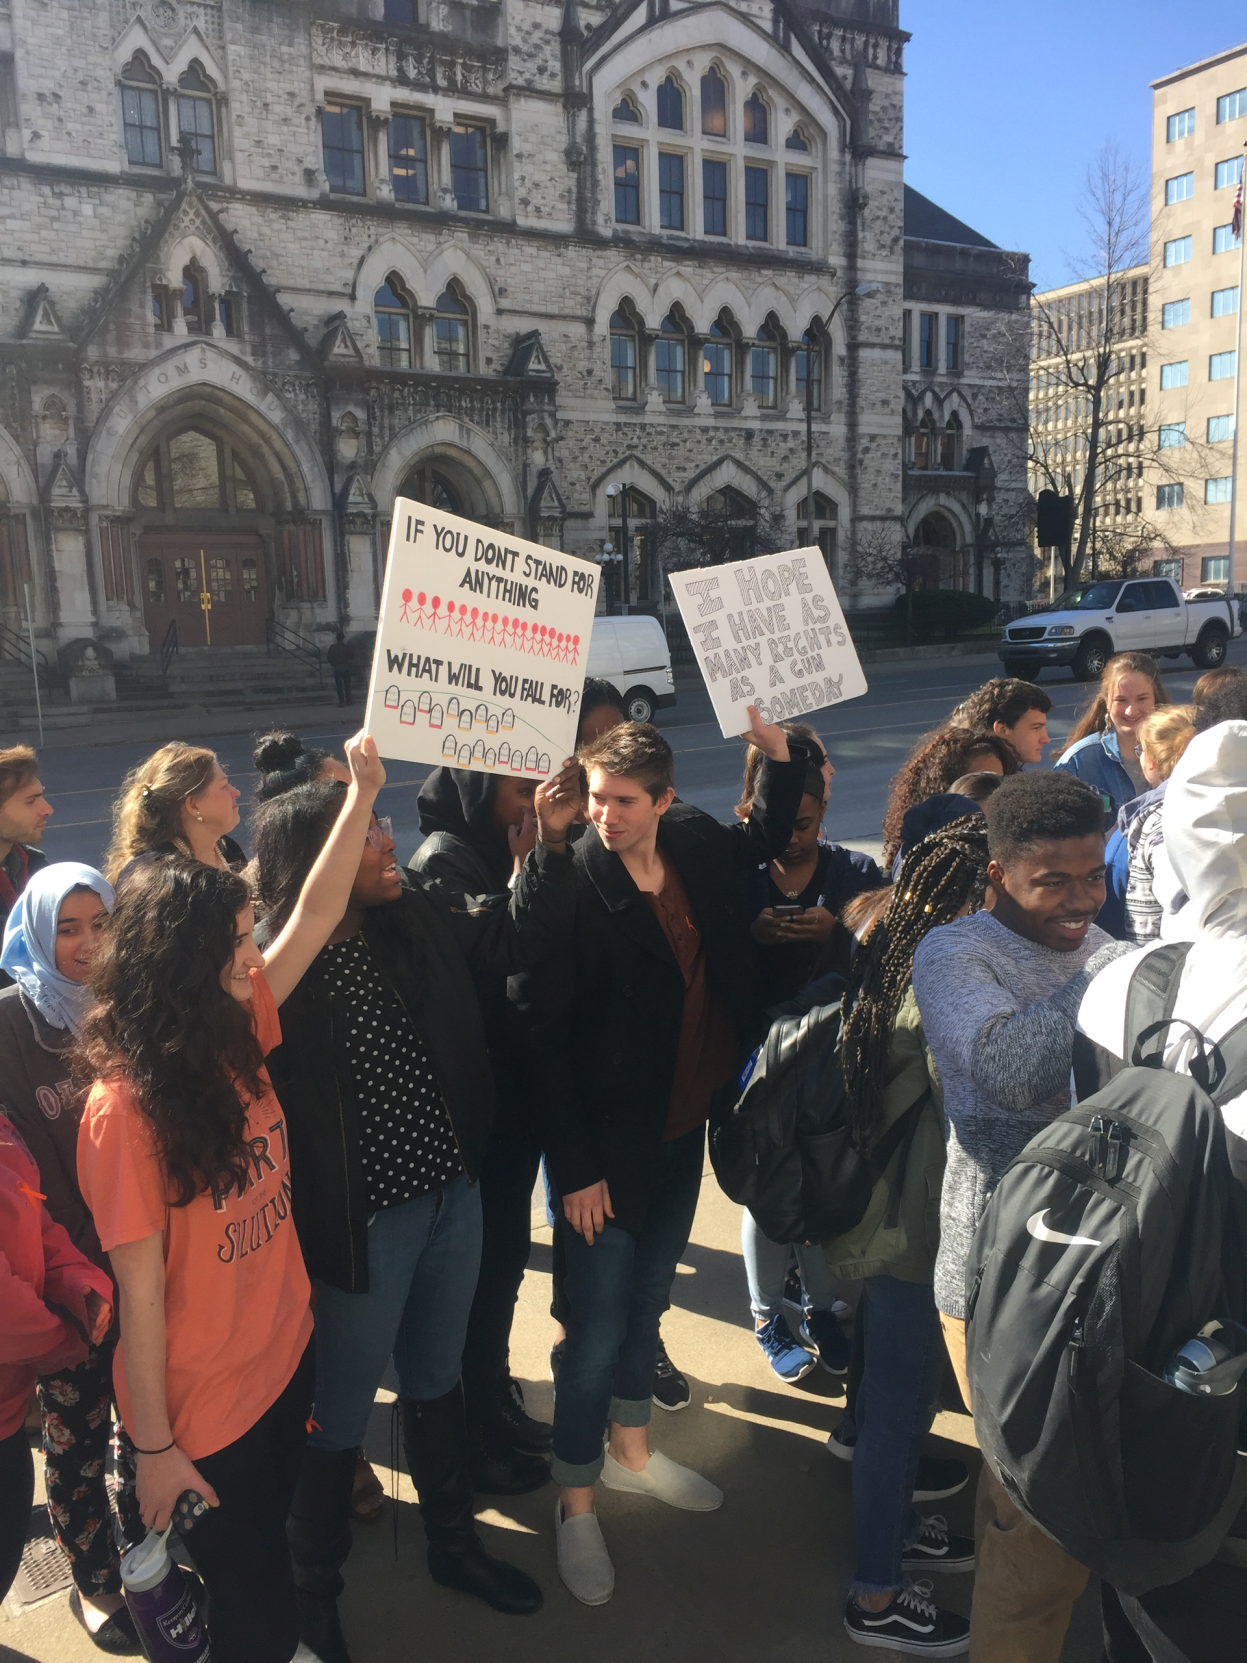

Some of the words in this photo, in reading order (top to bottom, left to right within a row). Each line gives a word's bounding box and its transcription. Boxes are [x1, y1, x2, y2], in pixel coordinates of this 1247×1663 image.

[406, 515, 425, 544] IF
[433, 524, 469, 558] YOU
[474, 538, 520, 573] DONT
[522, 554, 568, 588] STAND
[571, 570, 594, 599] FOR
[458, 566, 539, 611] ANYTHING
[685, 577, 724, 617] I
[734, 558, 813, 606] HOPE
[693, 619, 722, 652] I
[727, 603, 791, 644] HAVE
[800, 594, 832, 626] AS
[386, 648, 444, 683] WHAT
[447, 661, 484, 692] WILL
[491, 669, 519, 698] YOU
[520, 678, 546, 706] FALL
[549, 683, 580, 715] FOR?
[704, 642, 763, 683] MANY
[766, 623, 847, 664] RIGHTS
[729, 675, 756, 702] AS
[769, 664, 785, 688] A
[789, 653, 826, 679] GUN
[753, 673, 843, 726] SOMEDAY
